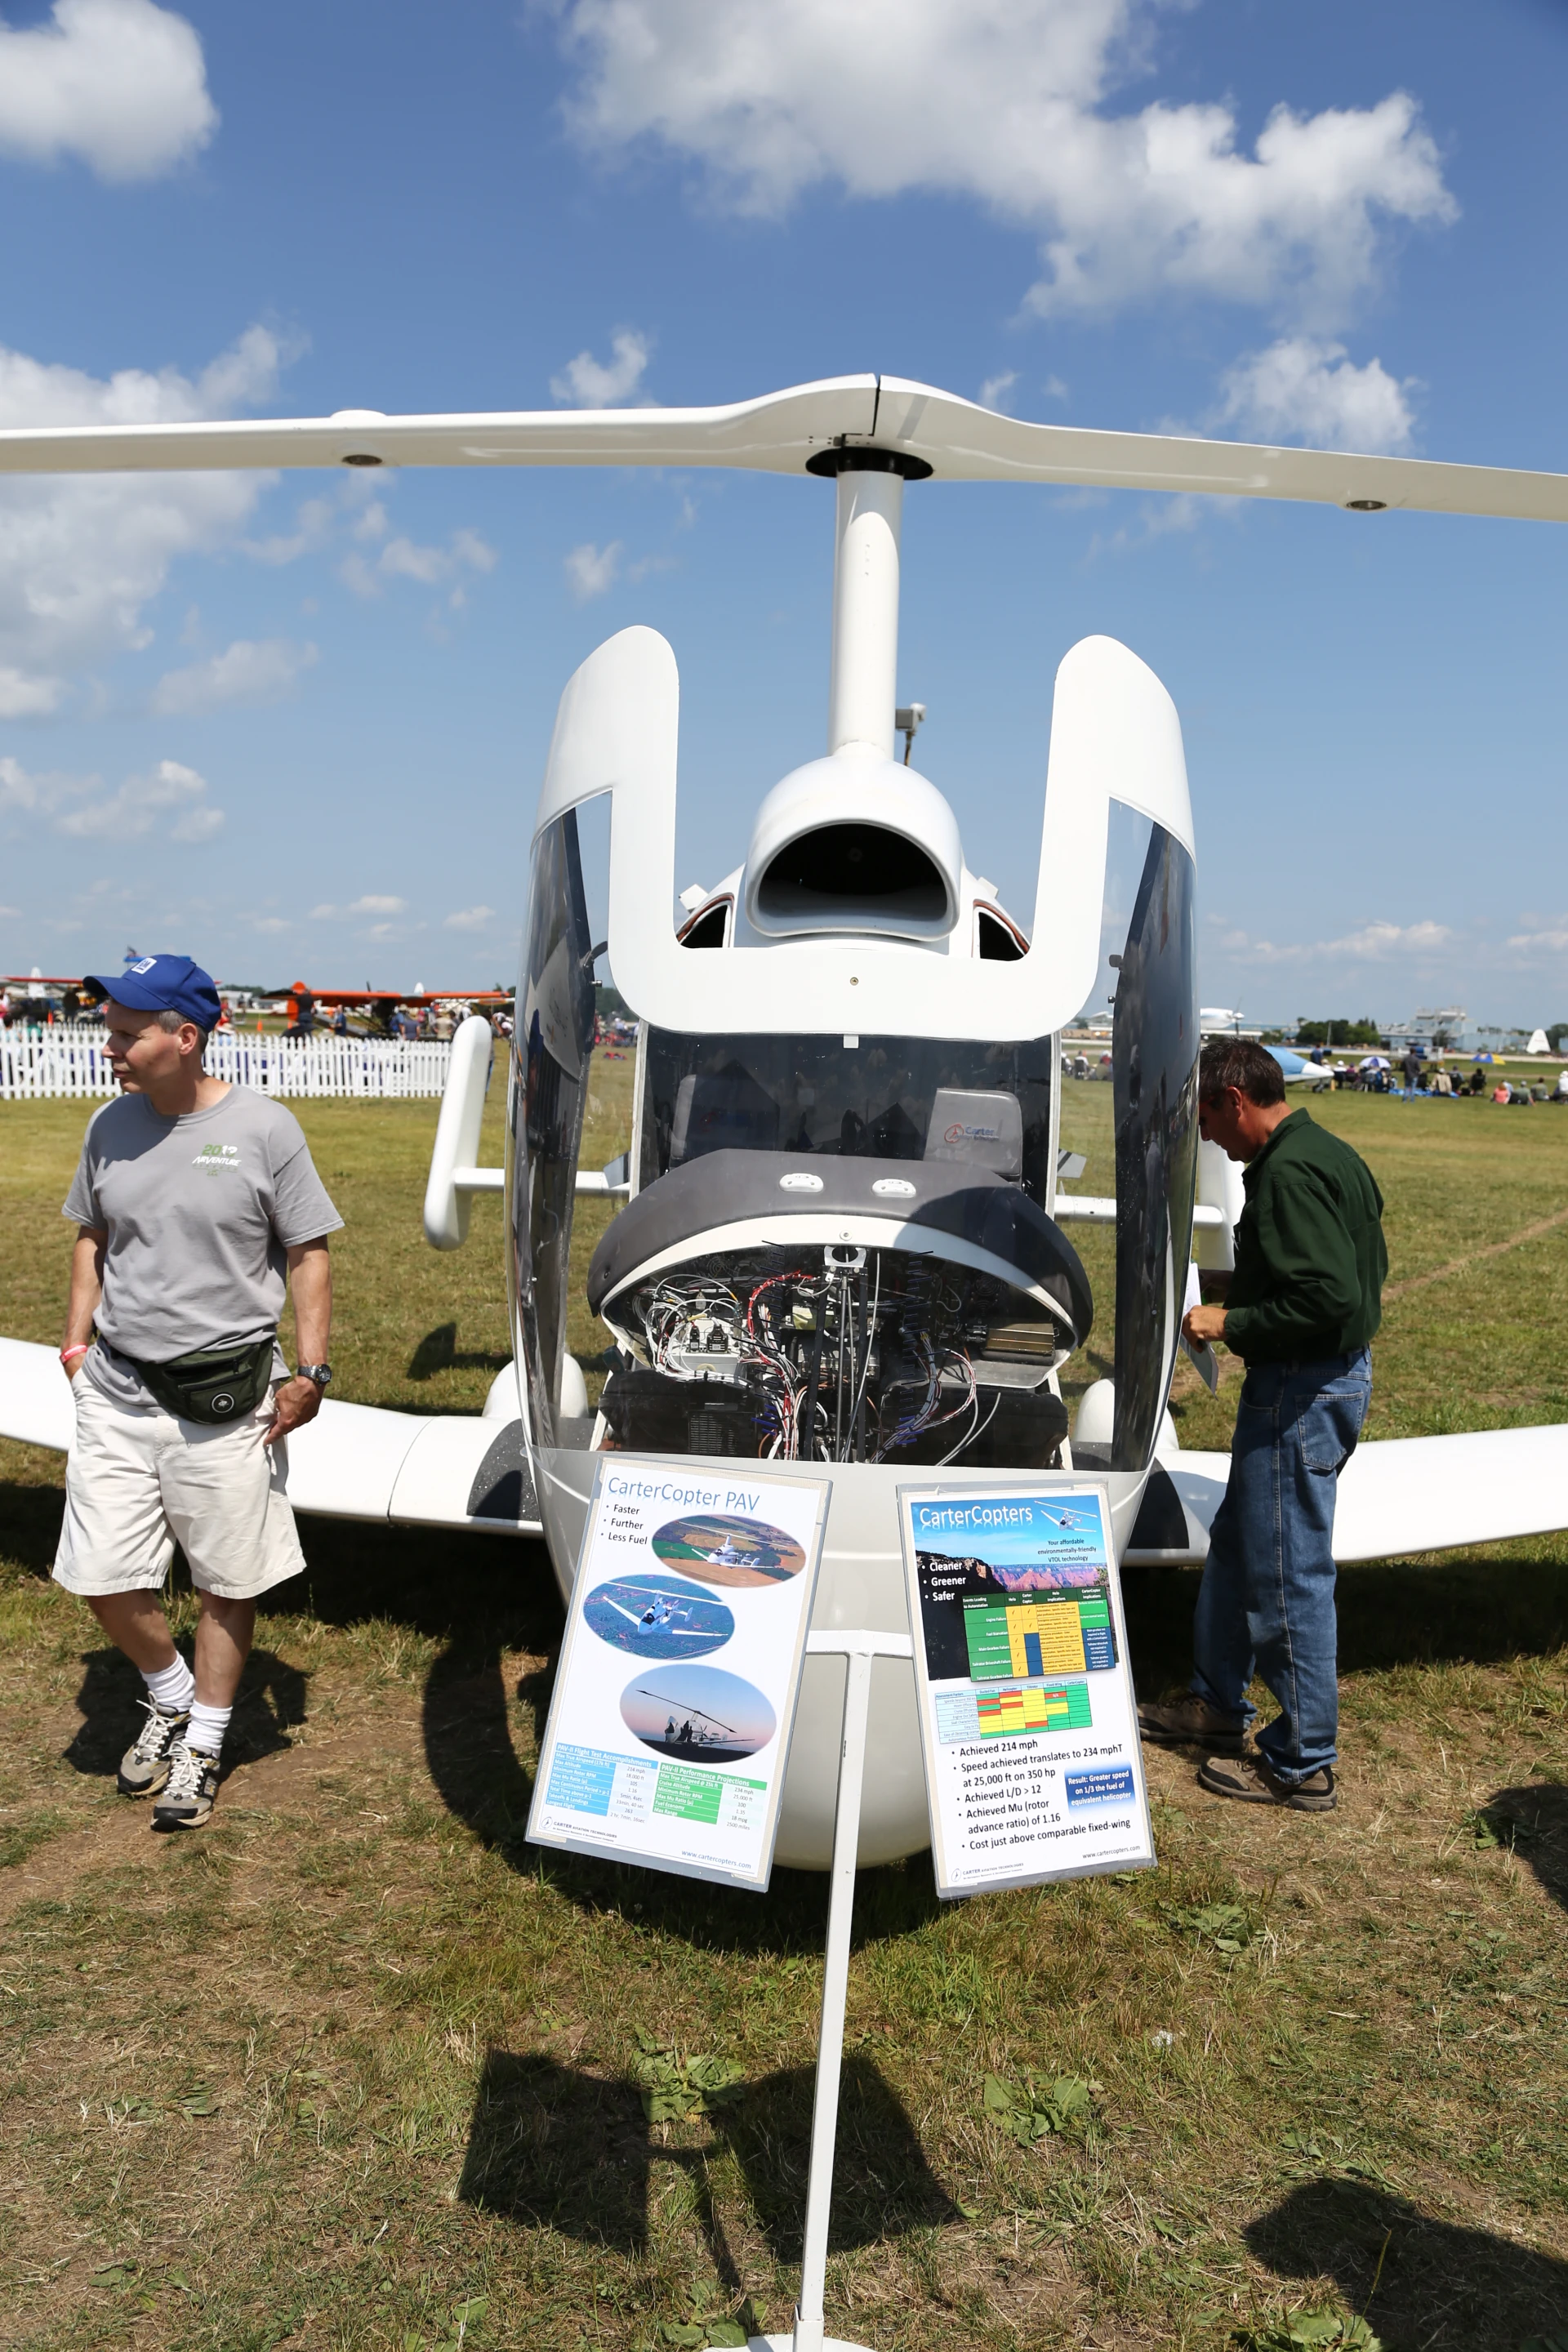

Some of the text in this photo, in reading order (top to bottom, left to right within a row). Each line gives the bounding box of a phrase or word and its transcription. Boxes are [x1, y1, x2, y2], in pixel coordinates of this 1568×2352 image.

[965, 1126, 995, 1136] Carter
[192, 1156, 242, 1166] AIRVENTURE
[608, 1477, 760, 1510] CarterCopter PAV
[612, 1503, 640, 1515] Faster
[919, 1504, 1033, 1526] CarterCopters
[610, 1517, 644, 1530] Further
[608, 1531, 648, 1544] Less Fuel
[1037, 1546, 1097, 1554] environmentally-friendly
[929, 1562, 963, 1571] Cleaner
[930, 1577, 967, 1585] Greener
[932, 1591, 956, 1601] Safer
[959, 1739, 1038, 1756] Achieved 214 mph
[557, 1744, 574, 1752] PAV-II
[574, 1747, 590, 1755] Flight
[602, 1753, 652, 1767] Accomplishments
[960, 1744, 1123, 1773] Speed achieved translates to 234 mphT
[553, 1765, 574, 1773] Minimum
[661, 1764, 750, 1786] PAV-II Performance Projections
[963, 1777, 972, 1787] at
[973, 1774, 1004, 1786] 25,000
[1004, 1772, 1012, 1781] ft
[1027, 1768, 1043, 1779] 350
[1045, 1767, 1056, 1777] hp
[1067, 1770, 1129, 1784] Result: Greater speed
[560, 1781, 584, 1789] Continuous
[657, 1786, 679, 1794] Minimum
[1084, 1784, 1094, 1793] 1/3
[1106, 1782, 1118, 1790] fuel
[1118, 1780, 1125, 1788] of
[548, 1792, 566, 1800] Takeoffs
[569, 1797, 589, 1805] Landings
[964, 1788, 1004, 1802] Achieved
[1006, 1787, 1022, 1797] L/D
[1031, 1784, 1042, 1793] 12
[1071, 1792, 1132, 1806] equivalent helicopter
[665, 1802, 685, 1811] Economy
[965, 1799, 1050, 1818] Achieved Mu (rotor
[968, 1812, 1061, 1833] advance ratio) of 1.16
[969, 1819, 1131, 1850] Cost just above comparable fixed-wing
[1082, 1846, 1141, 1858] www.cartercopters.com
[681, 1851, 751, 1869] www.cartercopters.com
